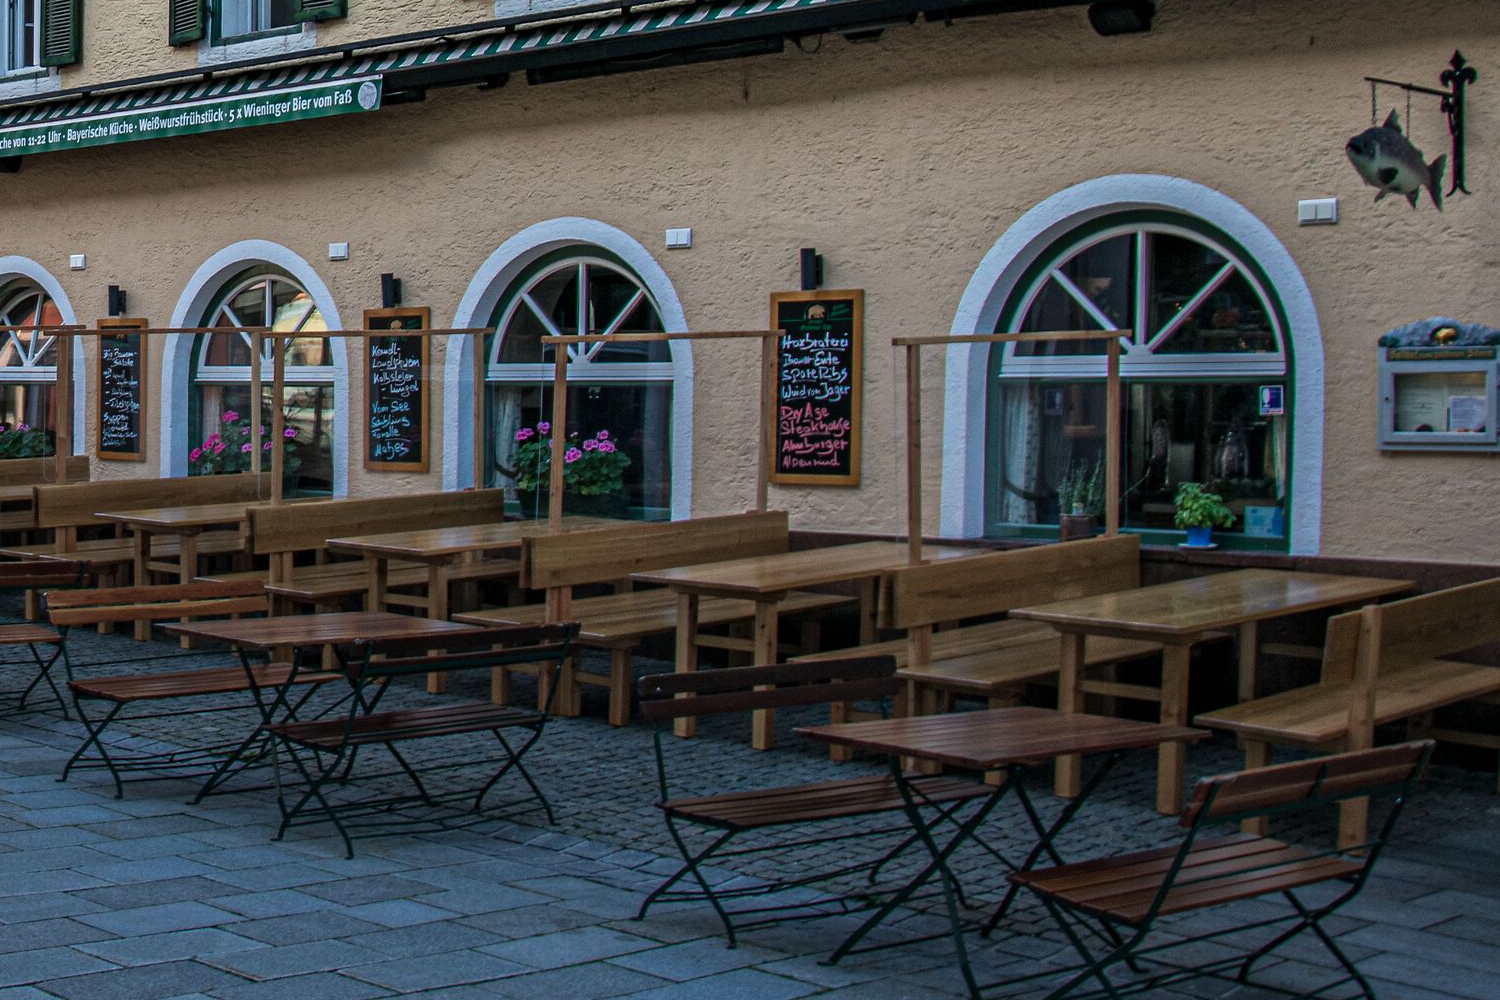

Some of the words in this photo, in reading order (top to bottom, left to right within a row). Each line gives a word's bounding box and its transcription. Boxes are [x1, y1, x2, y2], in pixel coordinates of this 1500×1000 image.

[13, 137, 26, 147] von
[28, 134, 46, 146] 11-22
[48, 131, 62, 144] Uhr
[67, 124, 108, 143] Bayerische
[109, 121, 133, 137] Küche
[139, 107, 224, 132] Weißwurstfrühstück
[229, 112, 235, 122] 5
[236, 109, 243, 118] x
[244, 100, 291, 117] Wieninger
[292, 96, 312, 111] Bier
[313, 96, 332, 109] vom
[334, 89, 353, 105] Faß
[390, 401, 411, 413] See
